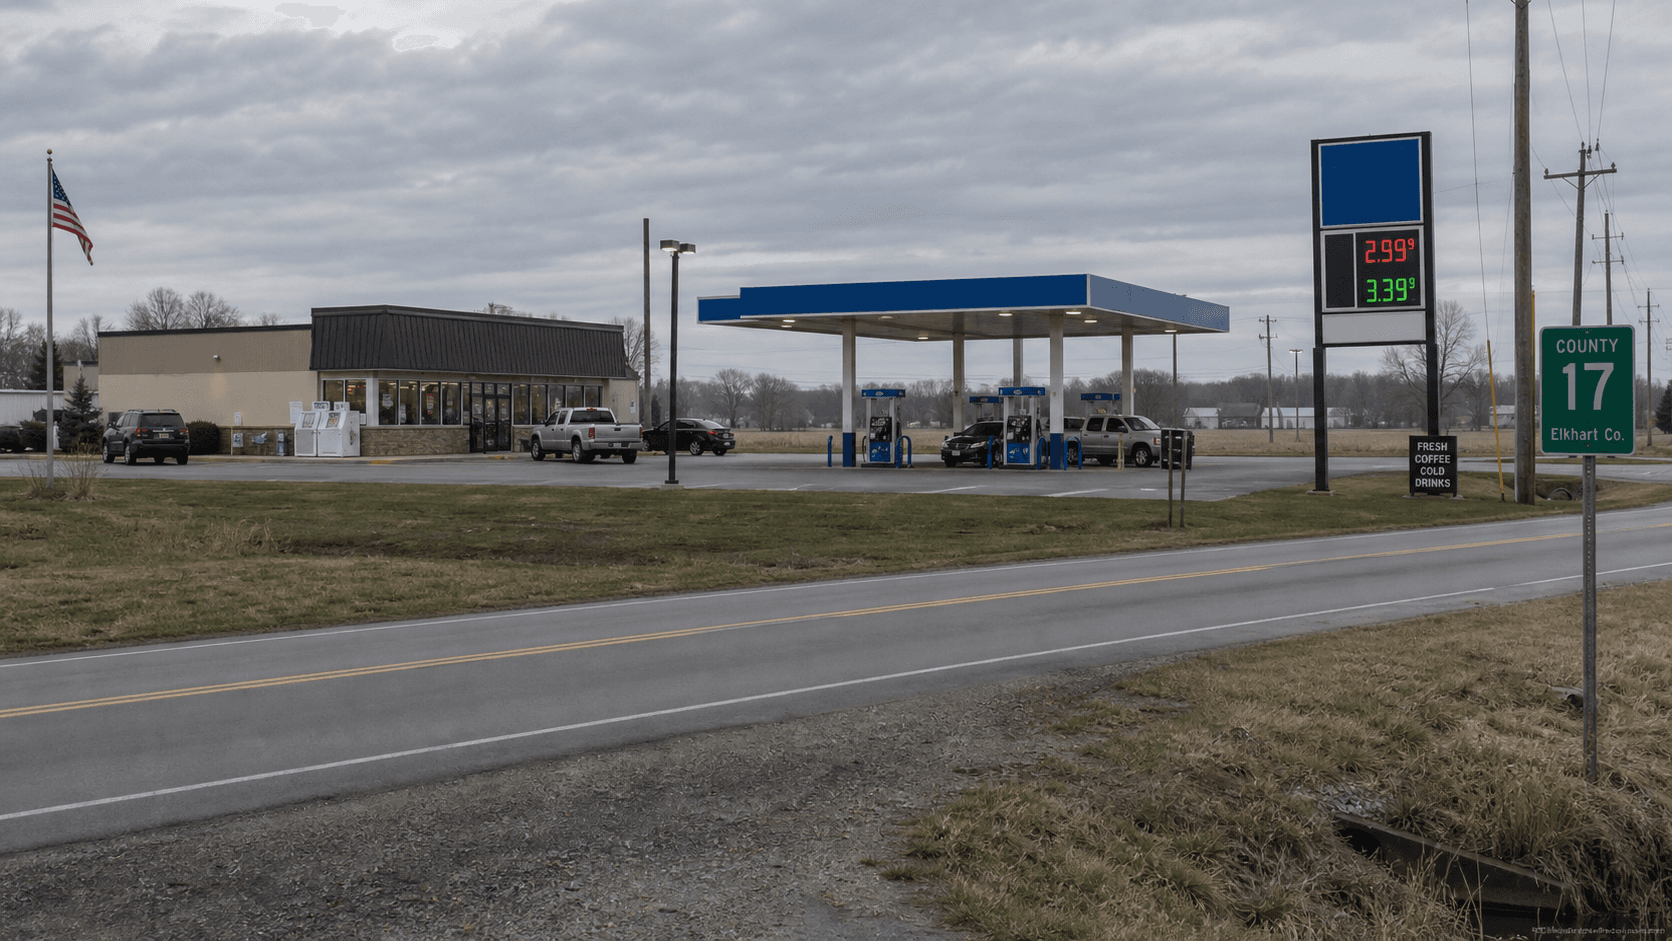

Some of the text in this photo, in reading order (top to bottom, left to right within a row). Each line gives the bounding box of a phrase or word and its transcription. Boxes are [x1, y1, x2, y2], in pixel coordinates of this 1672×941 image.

[1556, 338, 1619, 354] COUNTY
[1562, 362, 1615, 411] 17
[1551, 427, 1625, 441] Elkhart Co.
[1417, 442, 1448, 451] FRESH
[1414, 454, 1451, 464] COFFEE
[1420, 466, 1445, 476] COLD
[1415, 478, 1451, 488] DRINKS
